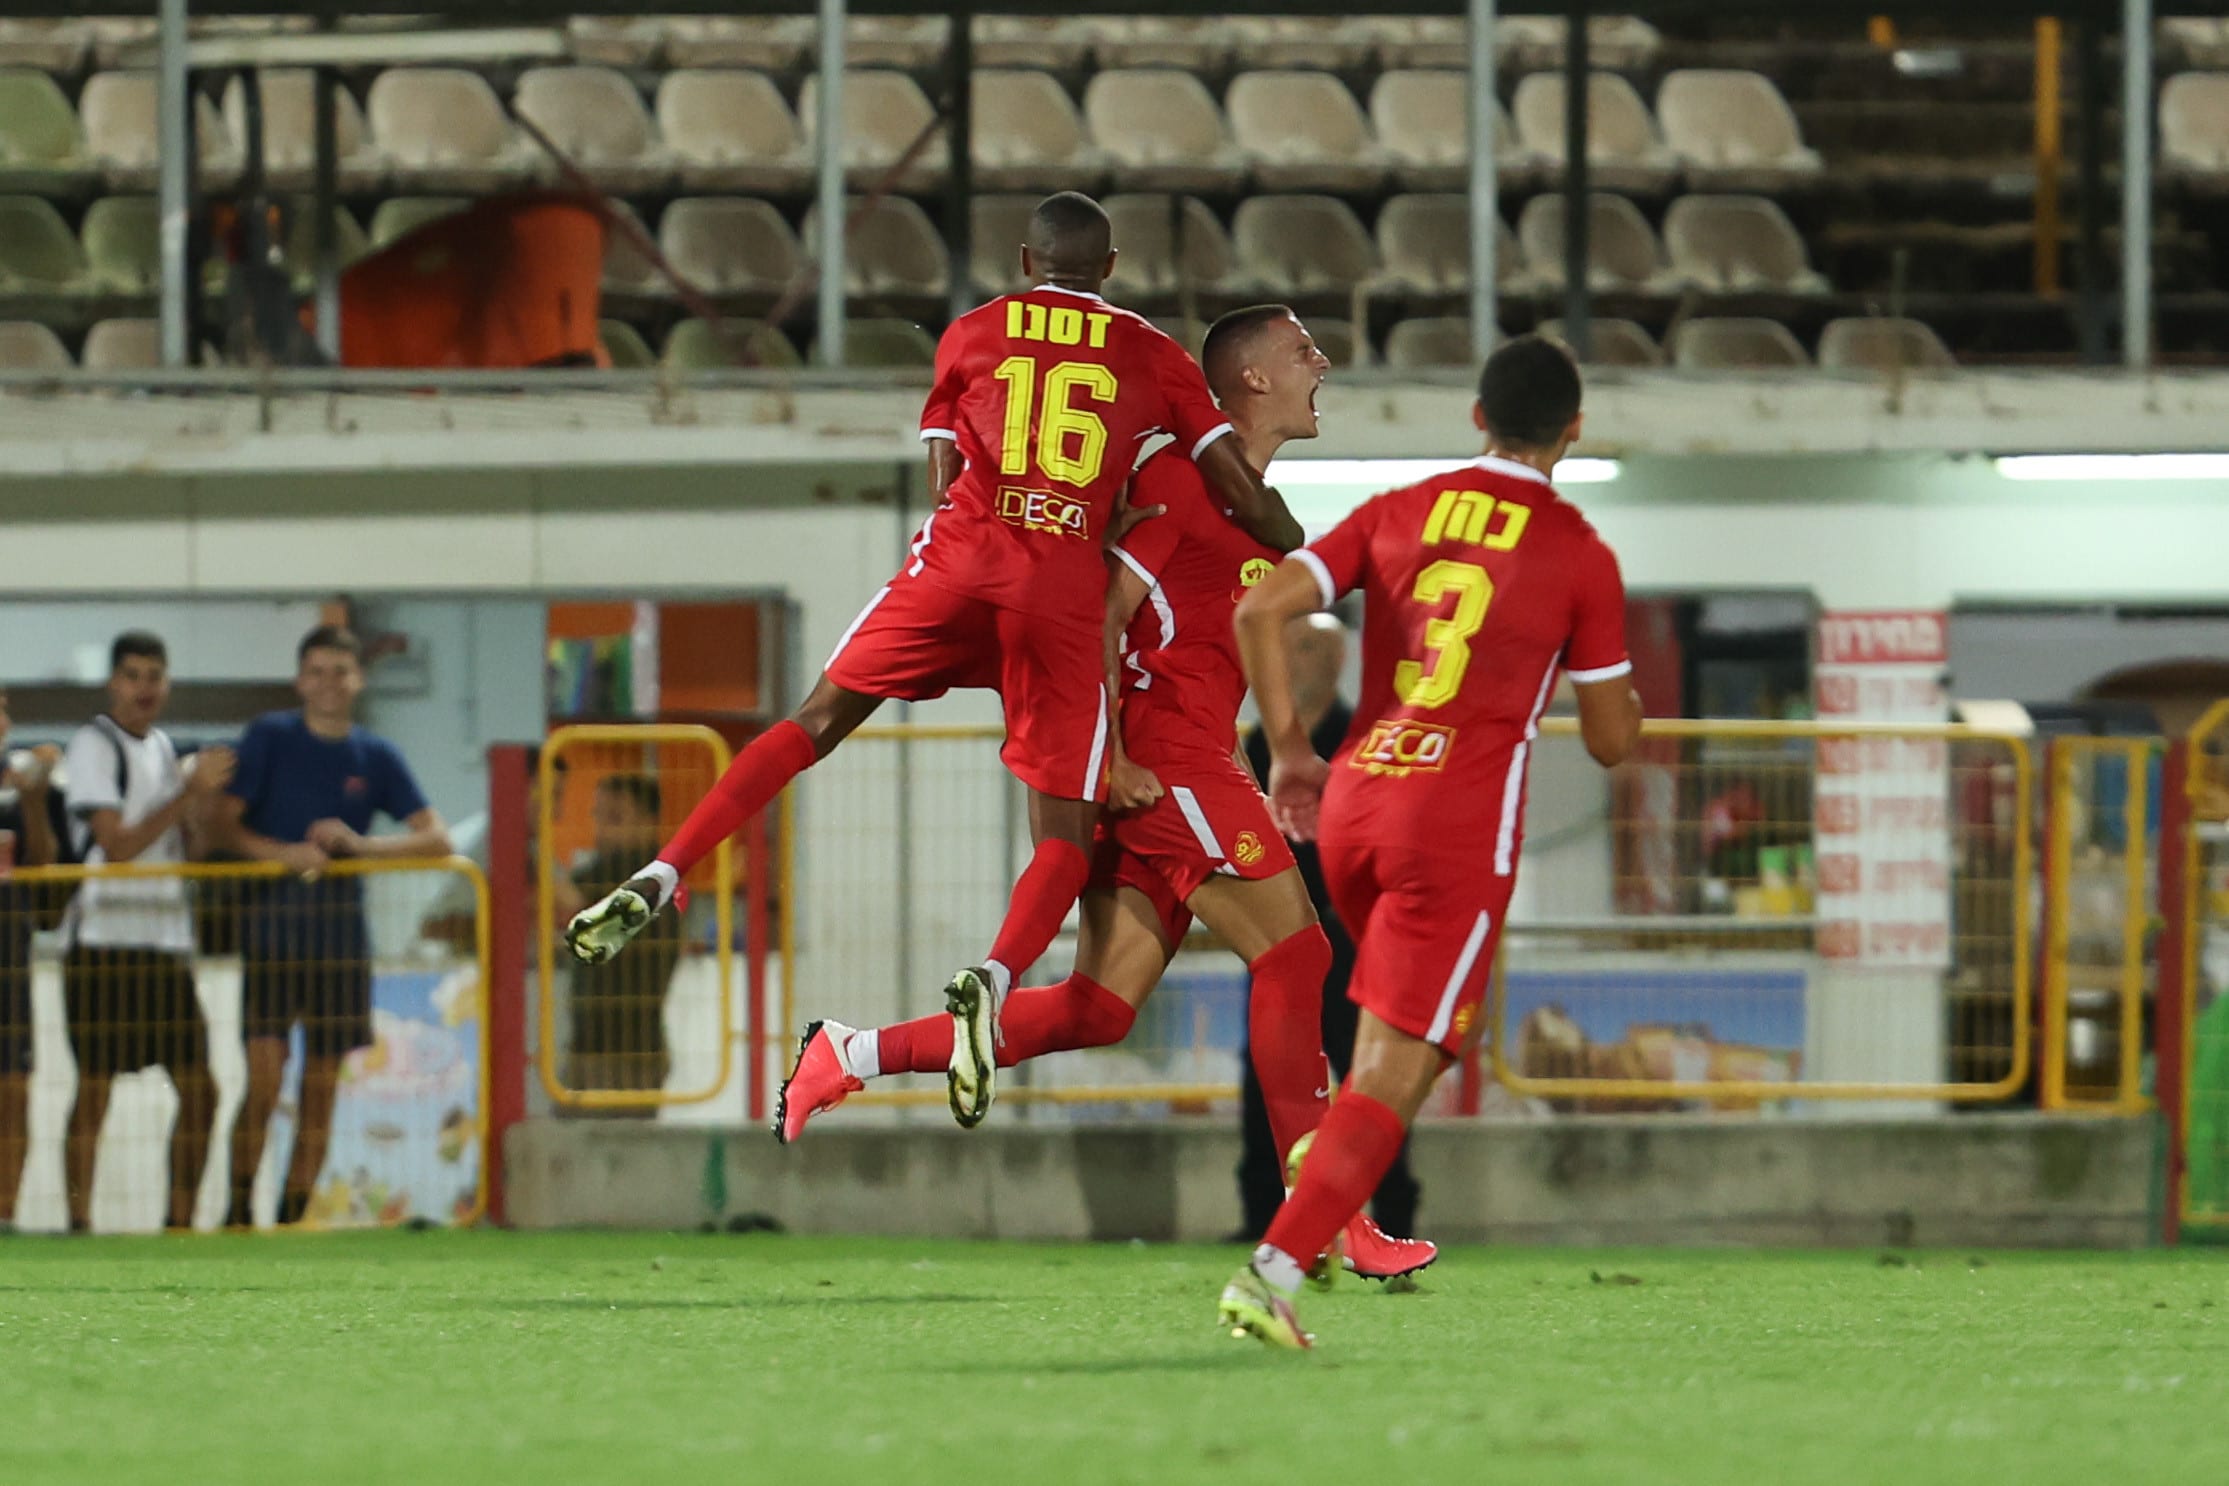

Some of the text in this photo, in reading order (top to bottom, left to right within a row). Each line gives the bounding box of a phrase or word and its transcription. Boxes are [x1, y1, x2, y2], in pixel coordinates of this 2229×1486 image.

[994, 356, 1118, 488] 16
[1002, 491, 1083, 528] DECO
[1421, 489, 1532, 551] כהן
[1393, 559, 1495, 709] 3
